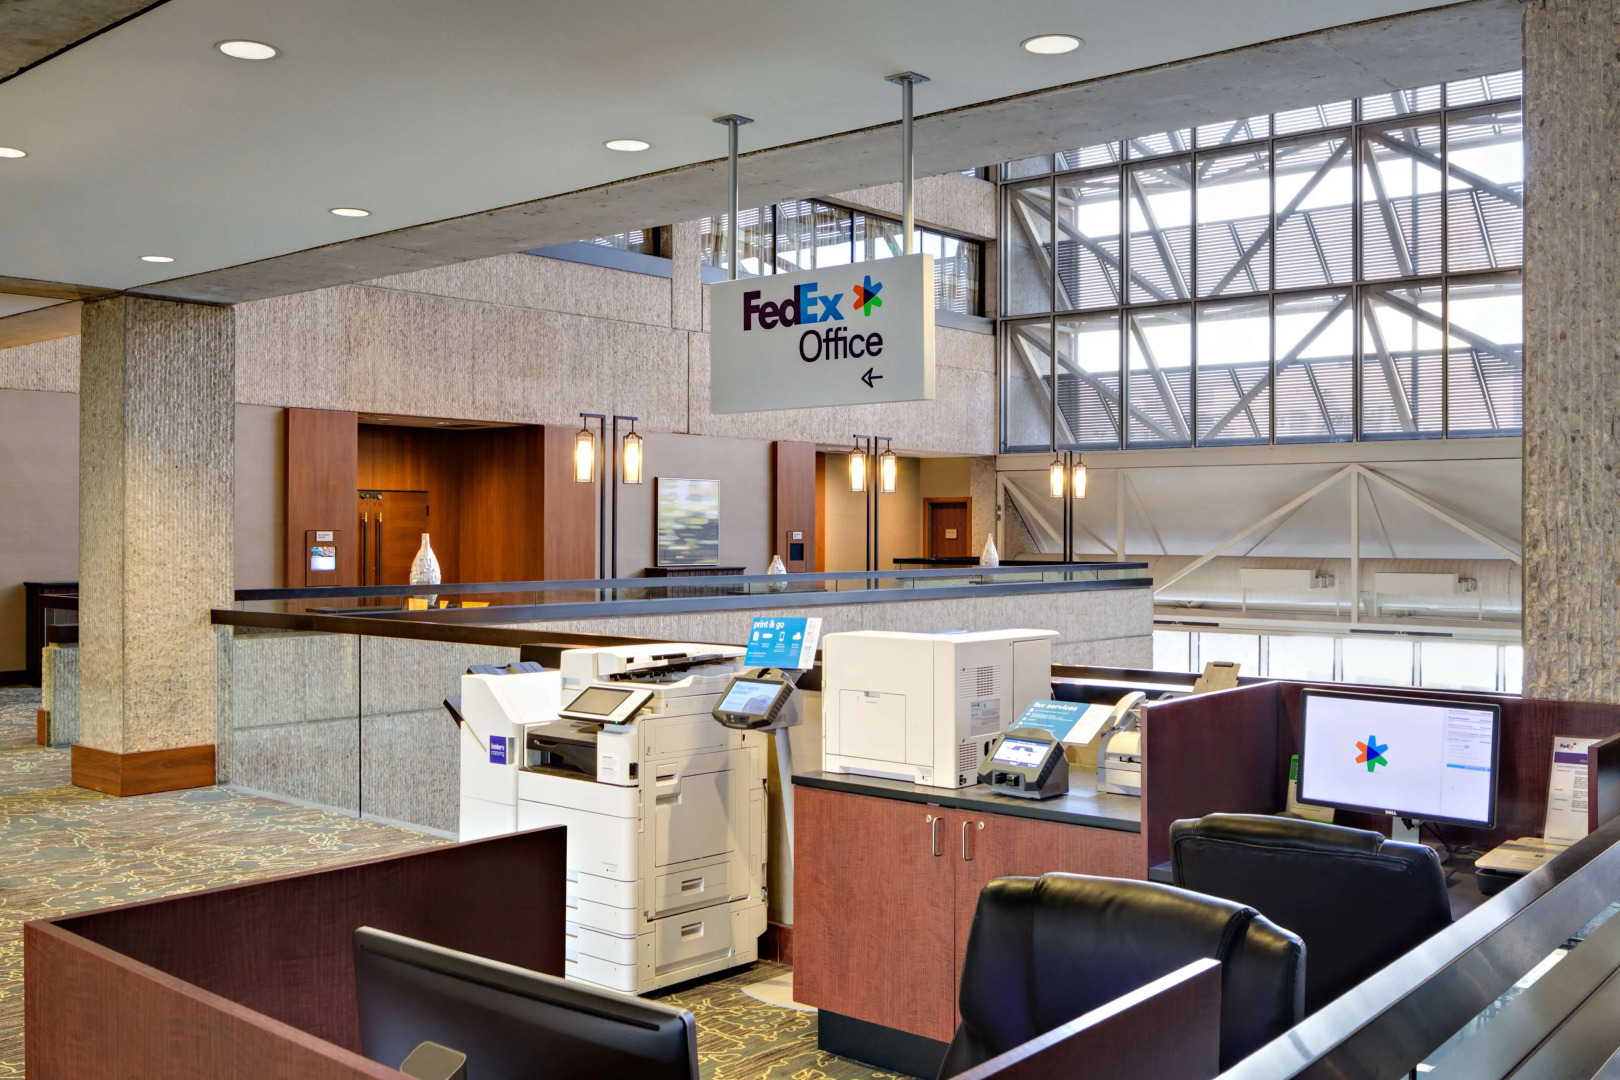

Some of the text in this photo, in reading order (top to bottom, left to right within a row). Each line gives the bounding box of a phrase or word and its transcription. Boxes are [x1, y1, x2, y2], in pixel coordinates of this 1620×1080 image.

[743, 282, 844, 331] FedEx
[799, 327, 883, 362] Office
[753, 620, 784, 630] print & go
